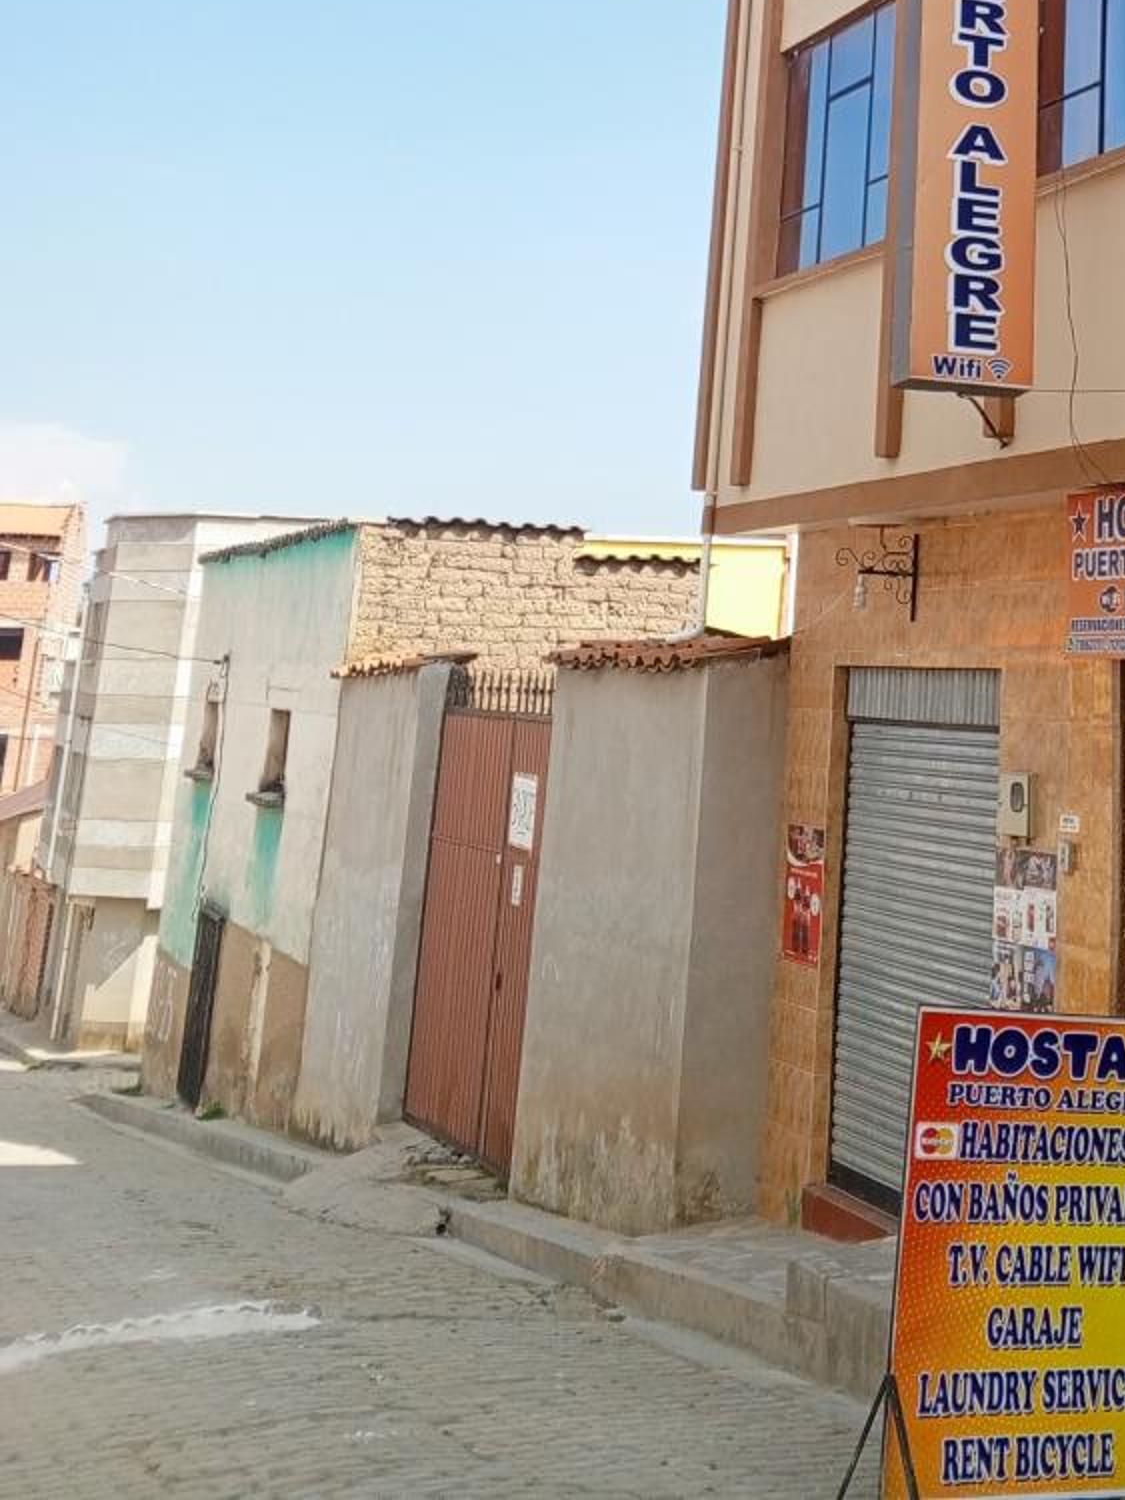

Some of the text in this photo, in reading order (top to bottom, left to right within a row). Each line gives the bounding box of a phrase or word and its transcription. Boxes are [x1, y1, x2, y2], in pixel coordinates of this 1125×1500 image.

[951, 125, 1004, 350] ALEGRE
[933, 356, 983, 379] Wifi
[948, 1084, 1051, 1109] PUERTO
[915, 1183, 966, 1221] CON
[971, 1173, 1049, 1223] BAÑOS
[948, 1244, 990, 1285] T.V.
[995, 1245, 1070, 1285] CABLE
[987, 1307, 1082, 1348] GARAJE
[918, 1370, 1037, 1417] LAUNDRY
[942, 1433, 1114, 1483] RENT BICYCLE
